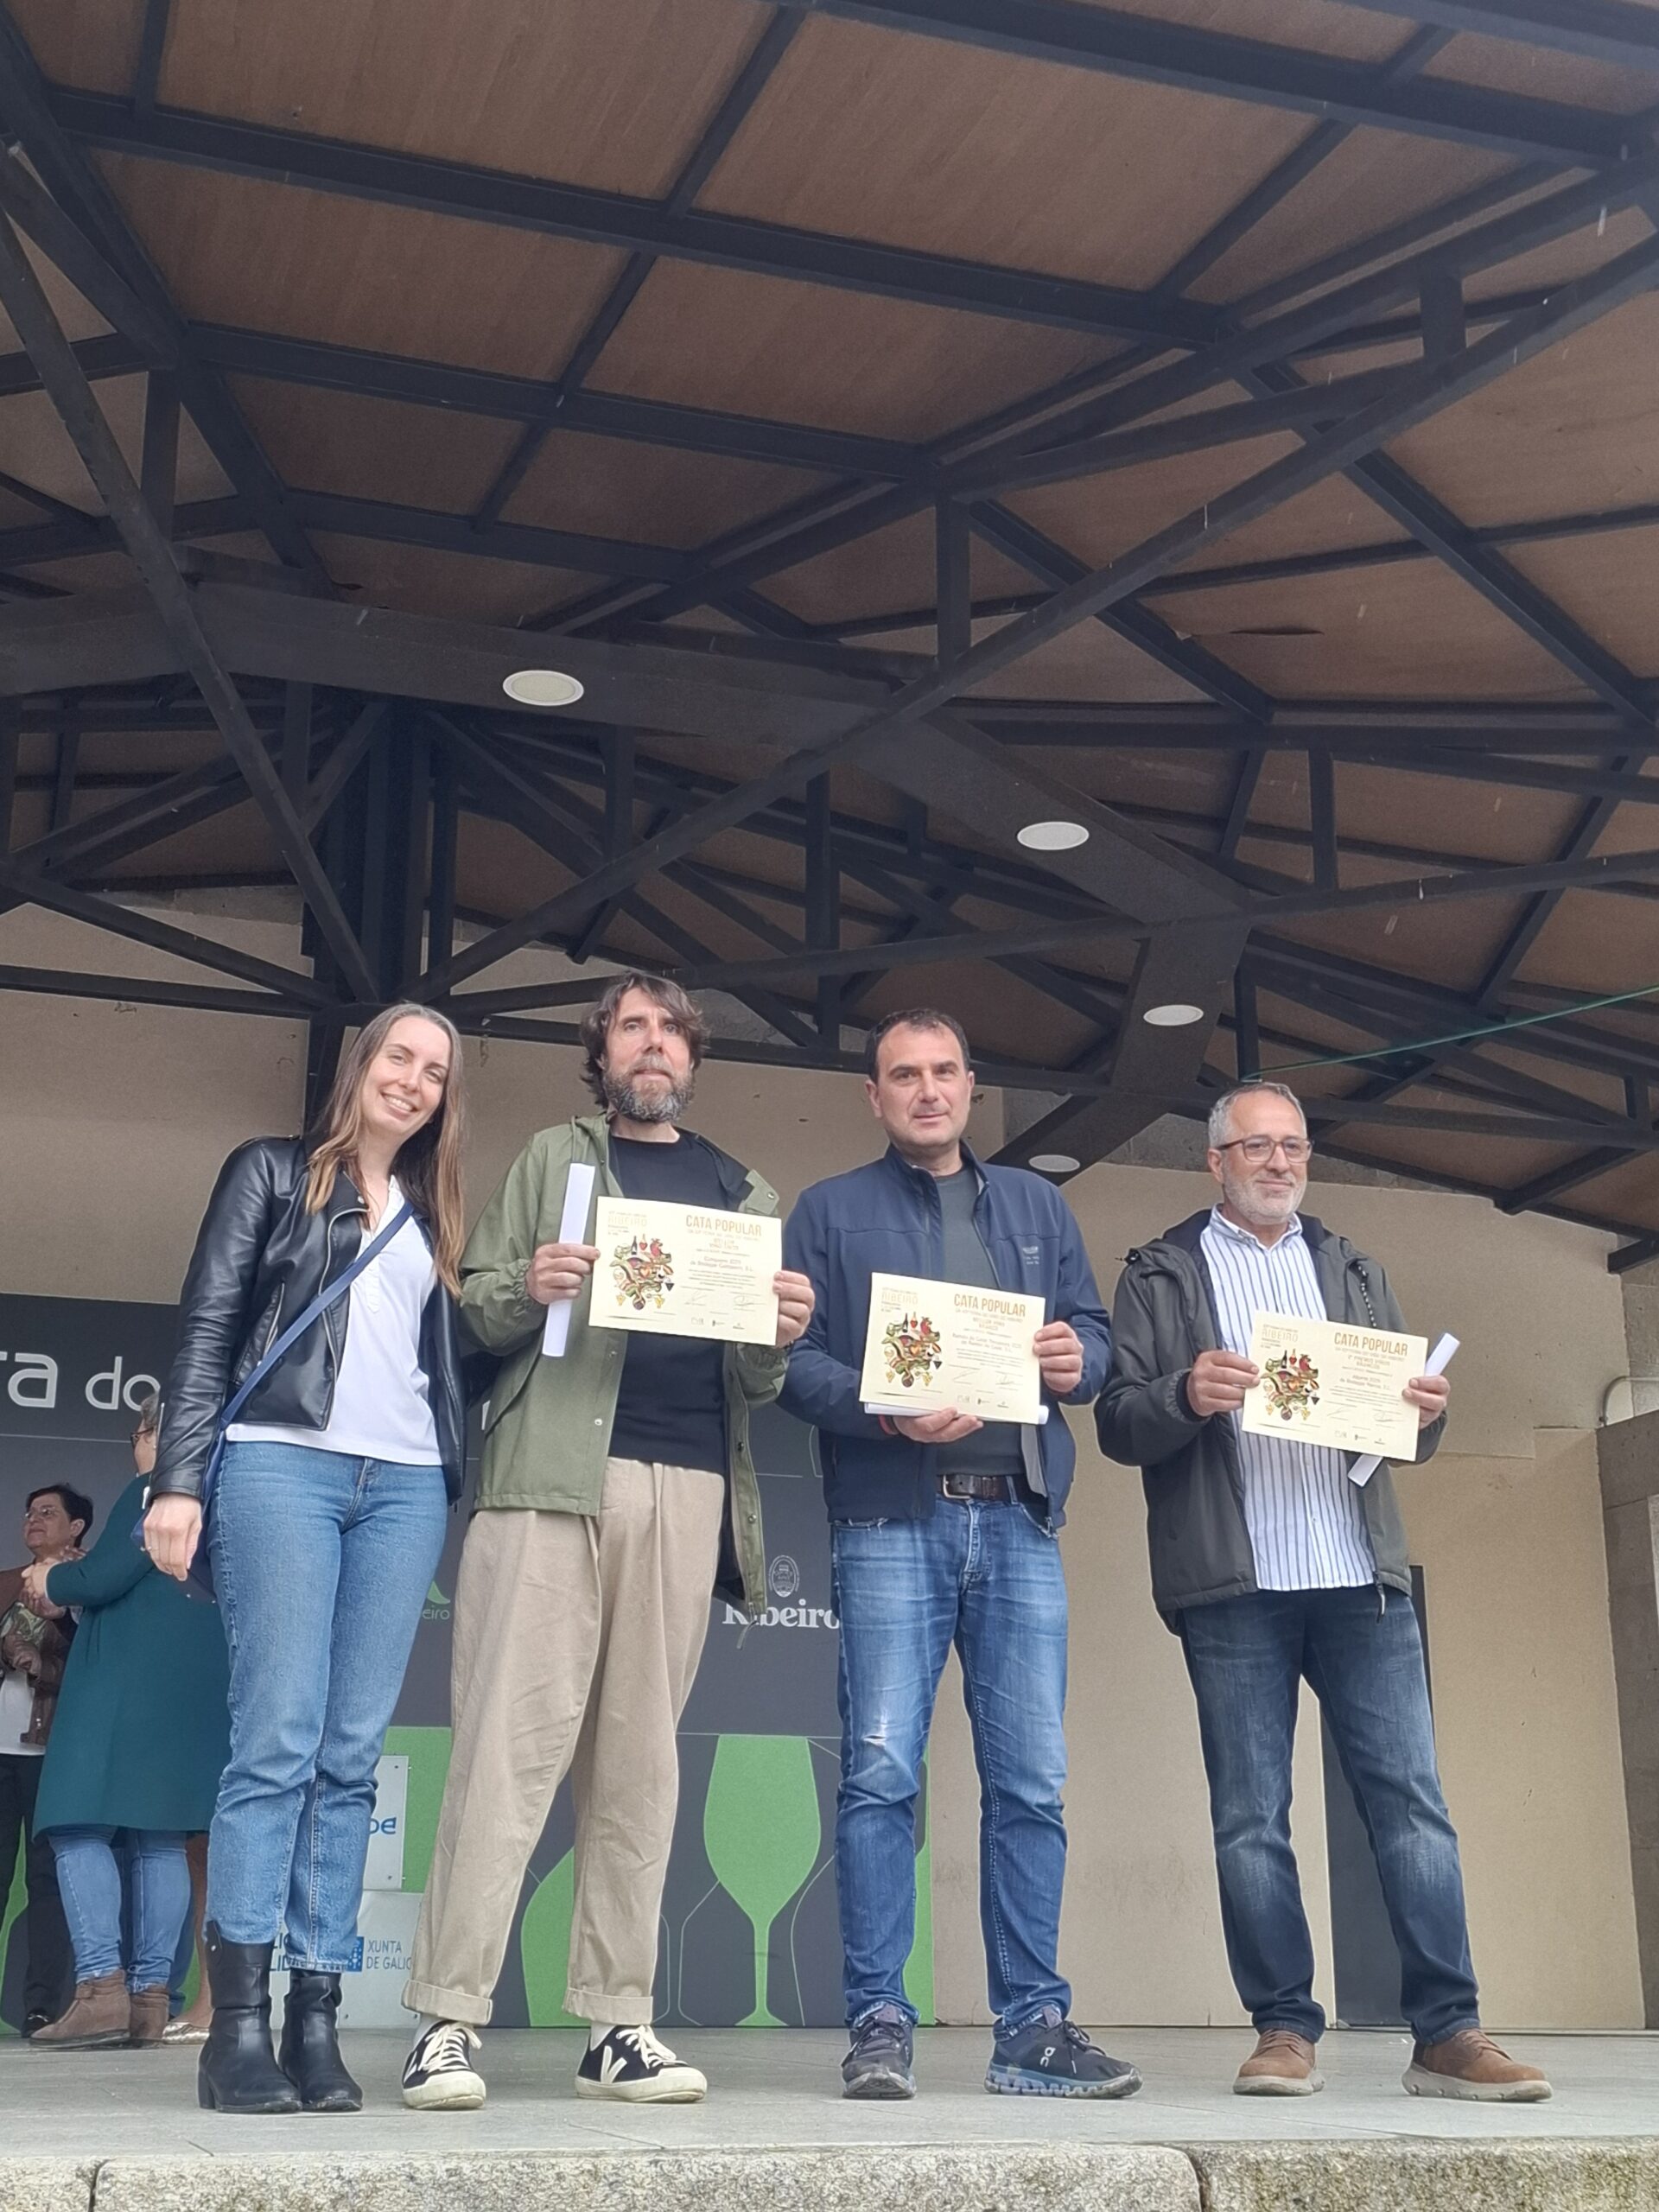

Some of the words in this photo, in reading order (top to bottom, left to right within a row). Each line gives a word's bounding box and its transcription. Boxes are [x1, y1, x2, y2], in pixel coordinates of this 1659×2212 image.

[686, 1215, 712, 1230] CATA
[715, 1218, 762, 1236] POPULAR
[954, 1294, 980, 1309] CATA
[982, 1297, 1027, 1318] POPULAR
[1334, 1332, 1360, 1348] CATA
[1362, 1337, 1408, 1356] POPULAR
[85, 1356, 161, 1412] do
[422, 1605, 450, 1620] eiro
[367, 1939, 402, 1953] XUNTA
[366, 1955, 380, 1969] DE
[383, 1956, 411, 1970] GALIC
